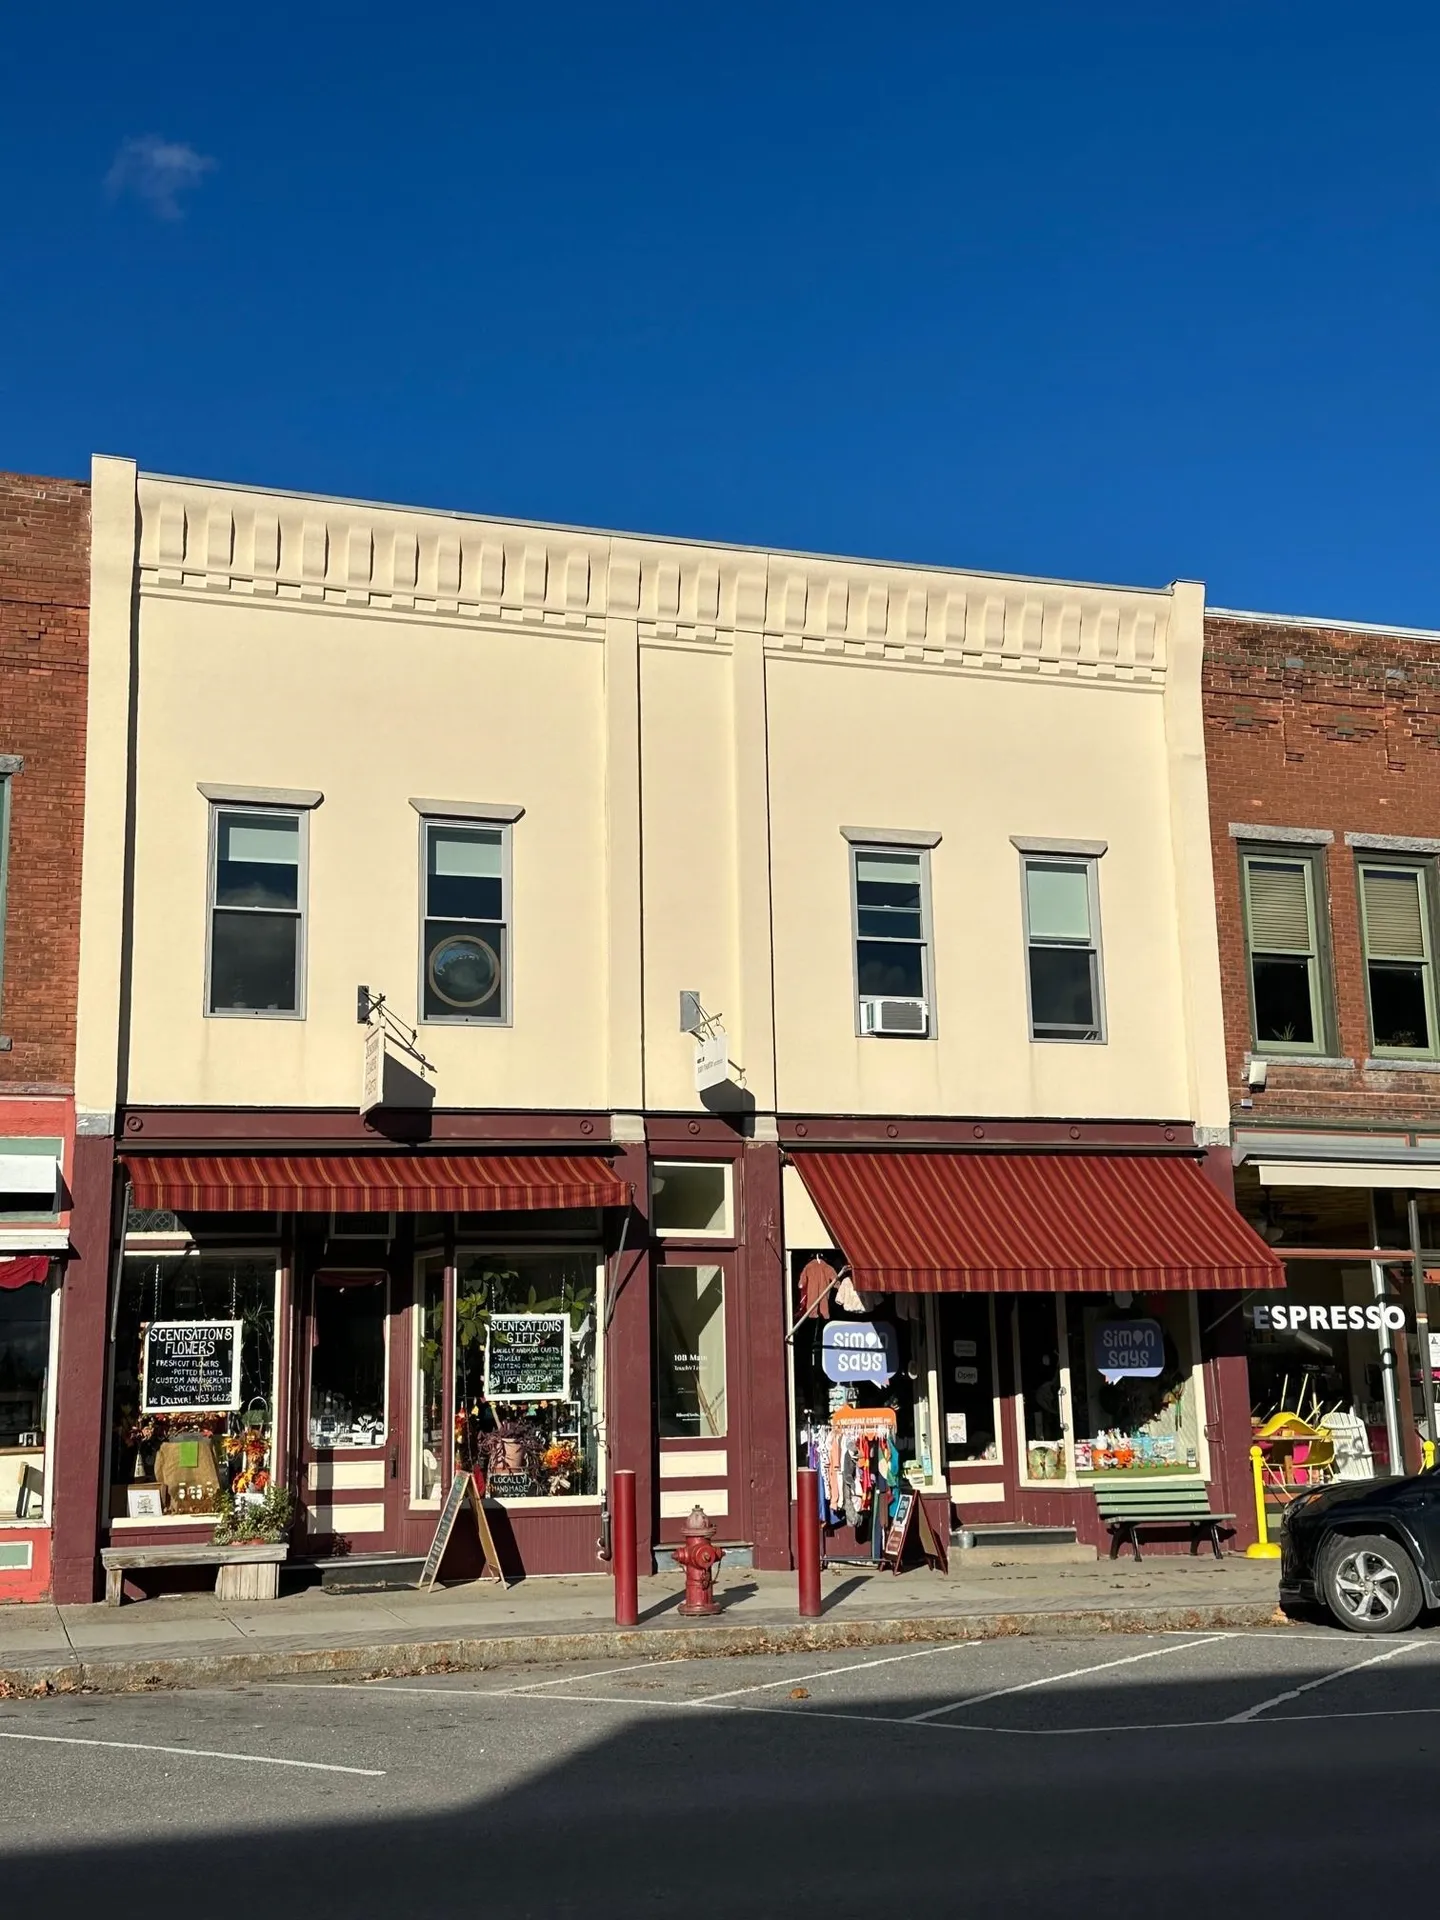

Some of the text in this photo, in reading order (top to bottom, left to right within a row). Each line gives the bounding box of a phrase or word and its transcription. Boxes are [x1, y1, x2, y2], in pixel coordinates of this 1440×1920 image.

[1253, 1305, 1406, 1330] ESPRESSO
[491, 1320, 562, 1332] SCENTSATIONS
[150, 1328, 233, 1341] SCENTSATIONS
[506, 1332, 541, 1344] GIFTS
[1103, 1329, 1155, 1347] simon
[165, 1341, 215, 1355] FLOWERS
[838, 1352, 883, 1371] says
[1108, 1350, 1149, 1367] says
[503, 1375, 554, 1384] LOCAL ARTISAN
[957, 1371, 977, 1380] Open
[517, 1384, 541, 1392] FOODS
[493, 1476, 526, 1484] LOCALLY
